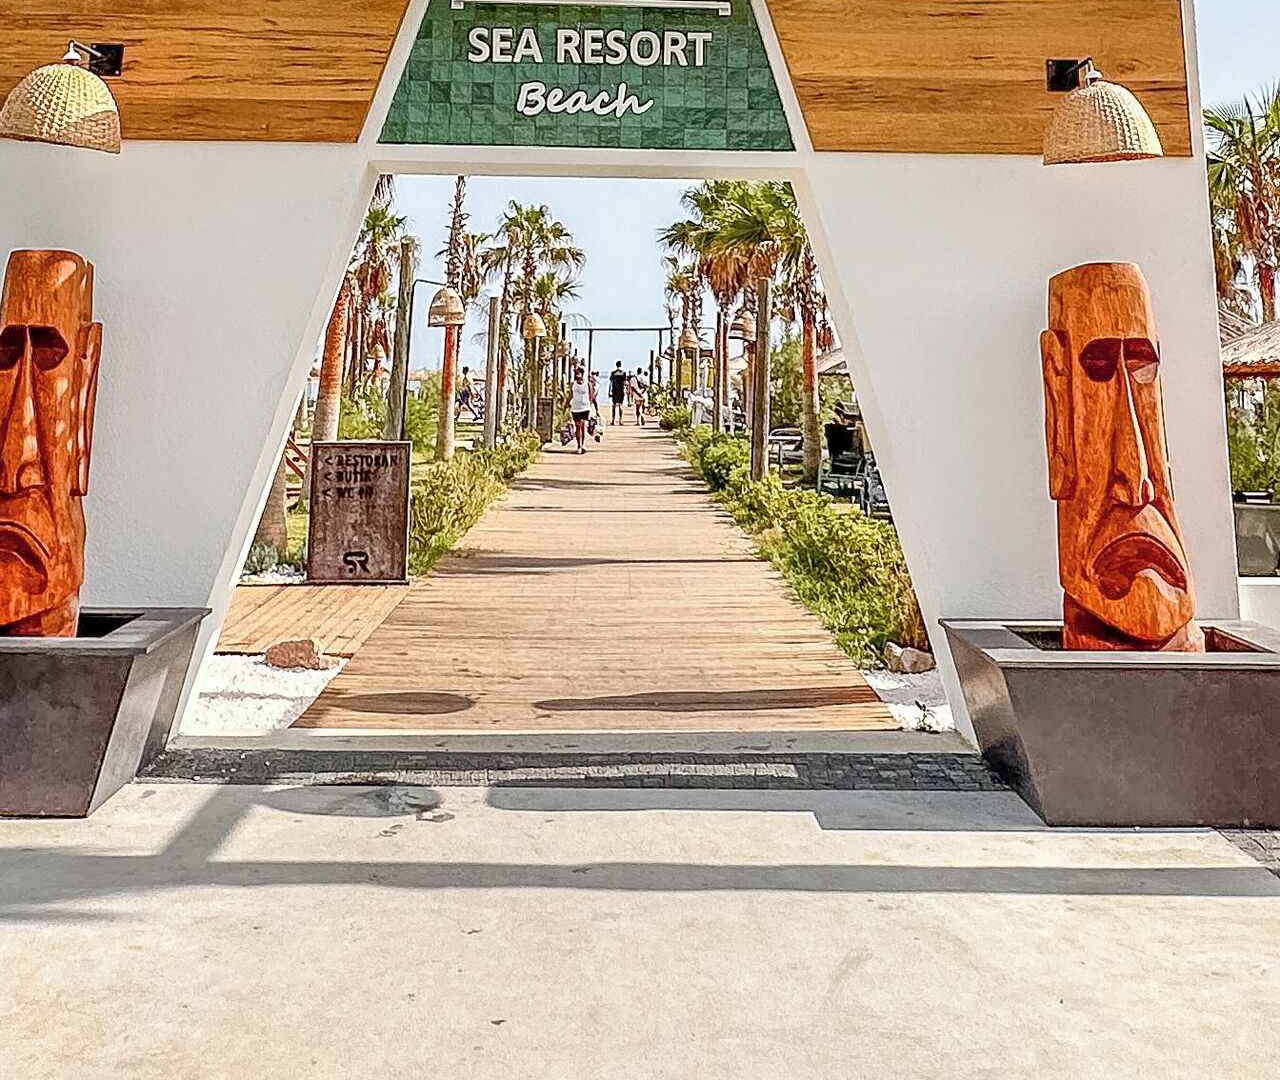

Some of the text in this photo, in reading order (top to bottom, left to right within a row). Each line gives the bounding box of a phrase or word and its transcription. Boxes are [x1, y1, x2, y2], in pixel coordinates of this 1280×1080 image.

[467, 28, 713, 67] SEA RESORT
[516, 81, 655, 119] Beach
[336, 454, 397, 467] RESTORAN
